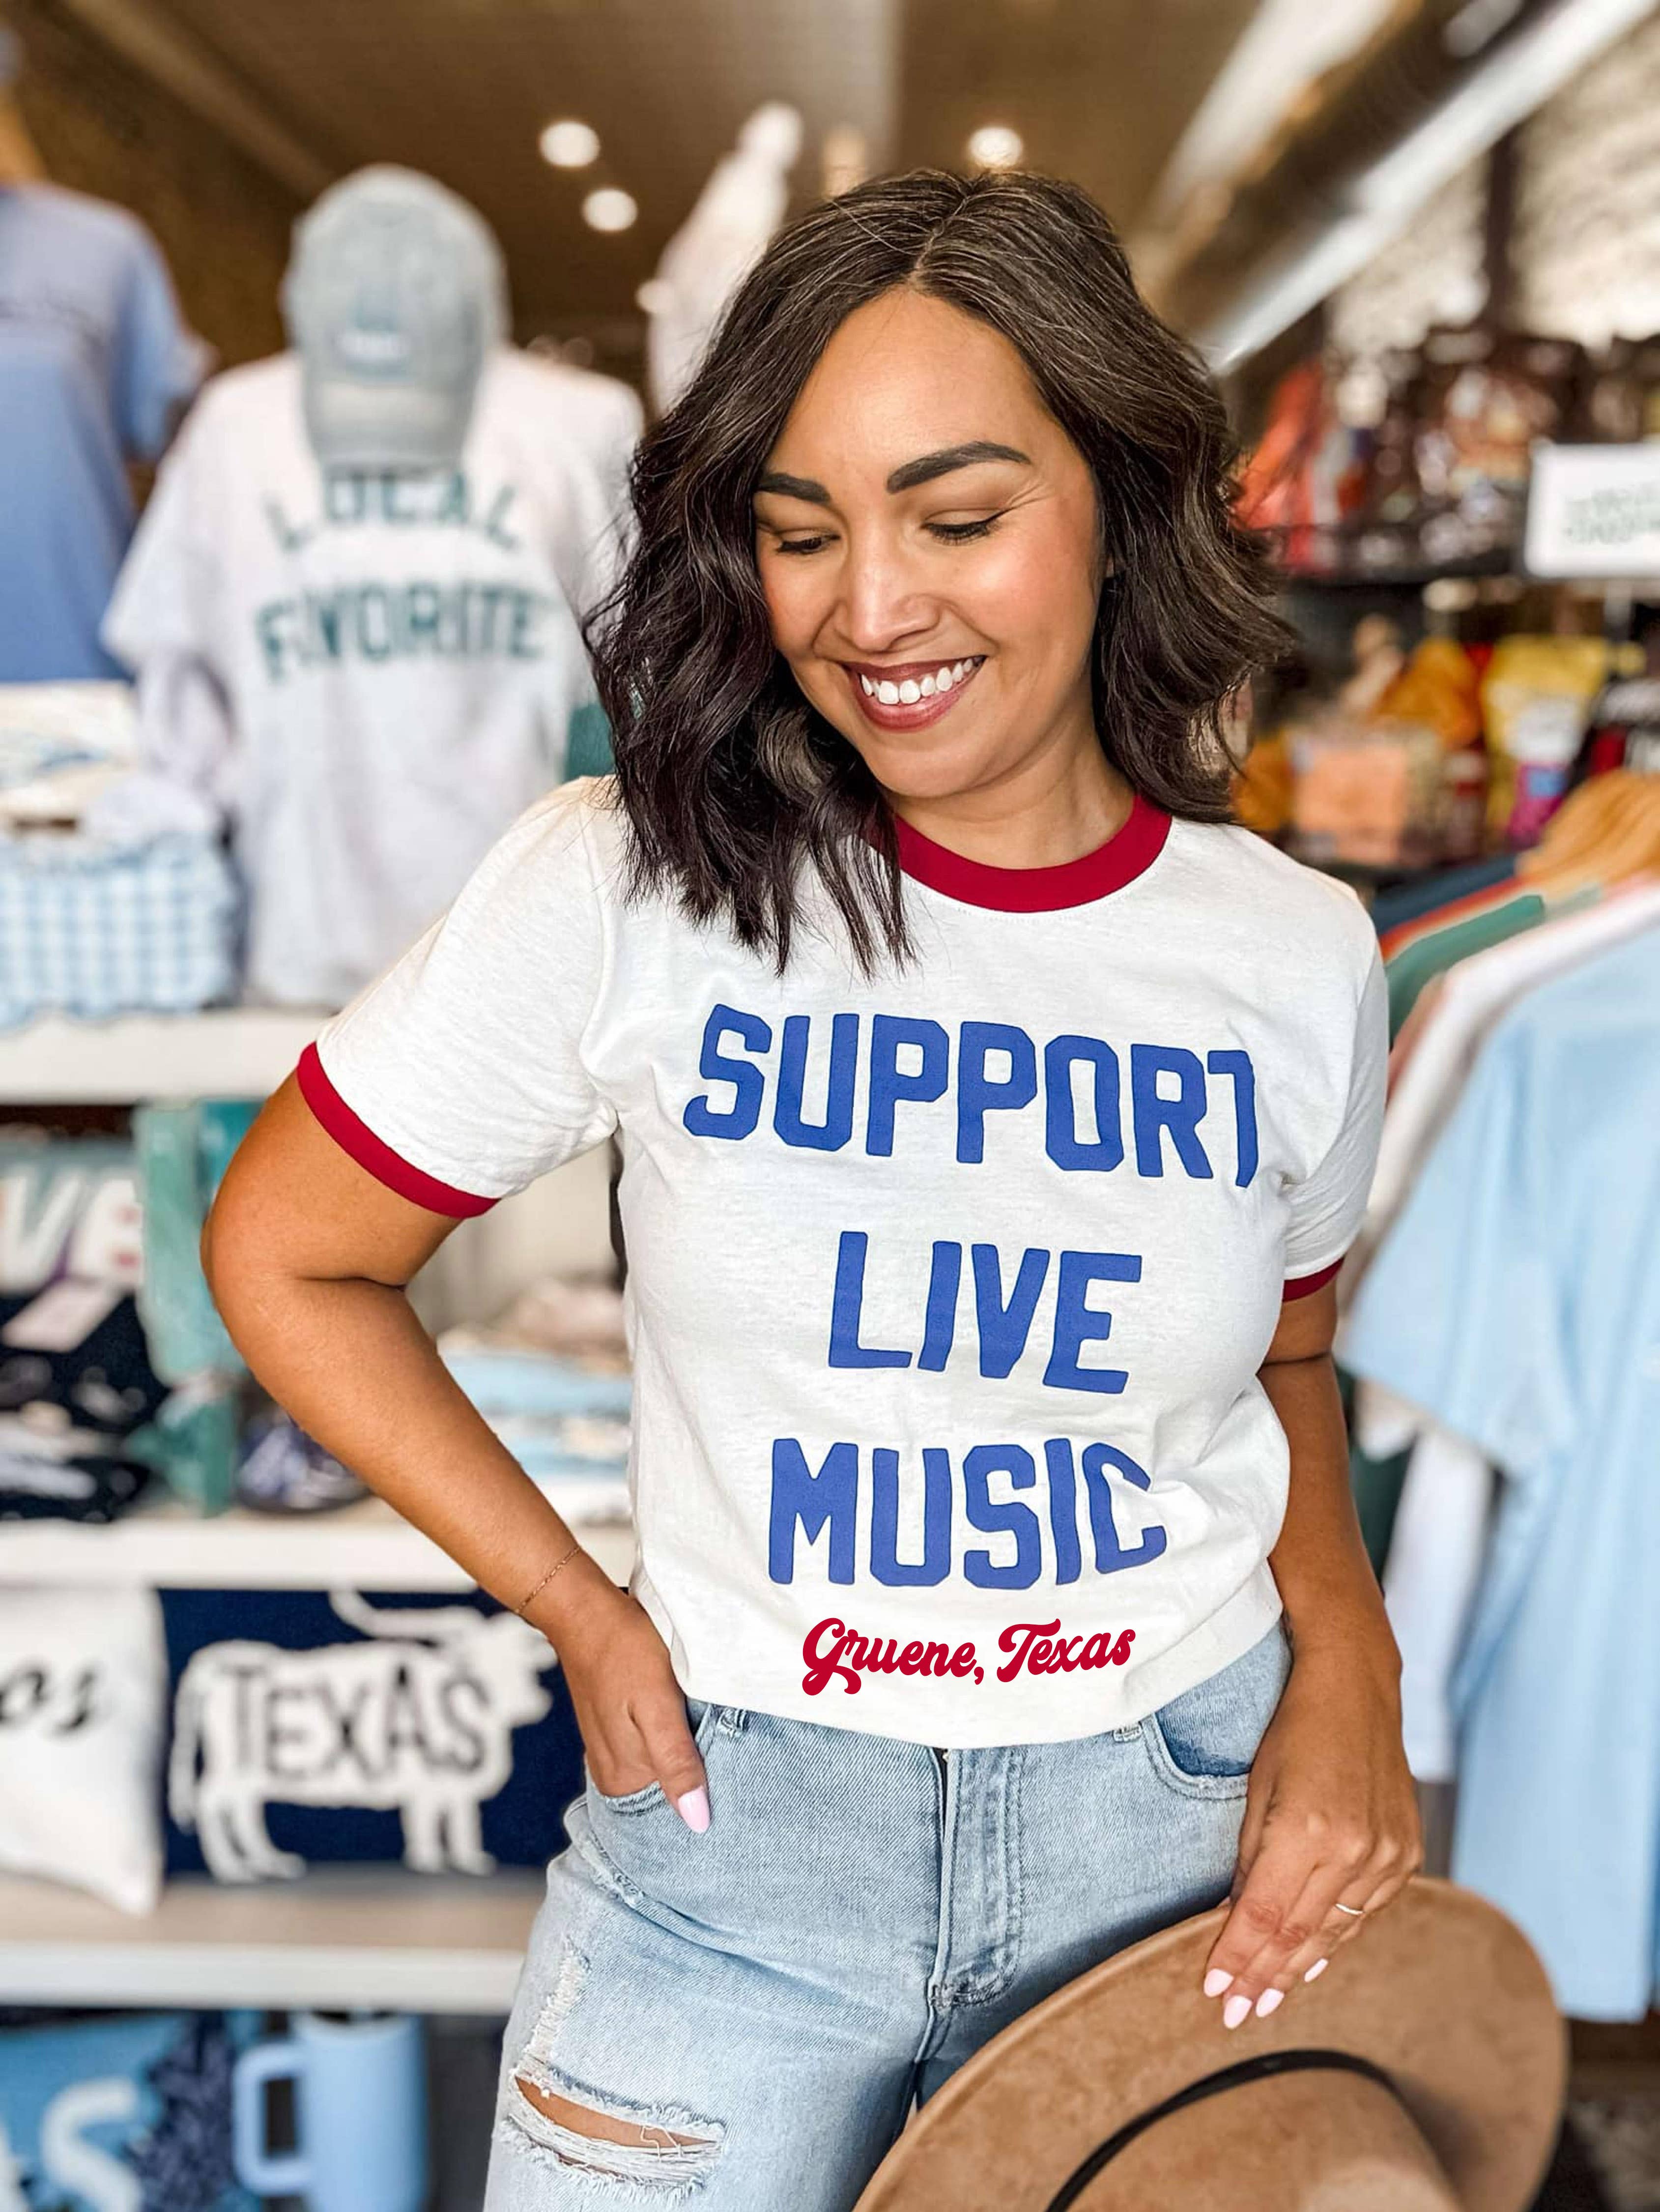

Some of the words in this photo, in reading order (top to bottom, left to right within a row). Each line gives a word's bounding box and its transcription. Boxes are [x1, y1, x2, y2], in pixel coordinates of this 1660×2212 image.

[261, 465, 520, 553] LOCAL
[255, 579, 544, 686] FAVORITE
[683, 1003, 1259, 1187] SUPPORT
[828, 1231, 1142, 1394] LIVE
[769, 1438, 1166, 1589] MUSIC
[801, 1617, 985, 1696] Gruene,
[996, 1618, 1136, 1683] Texas
[220, 1660, 491, 1780] TEXAS
